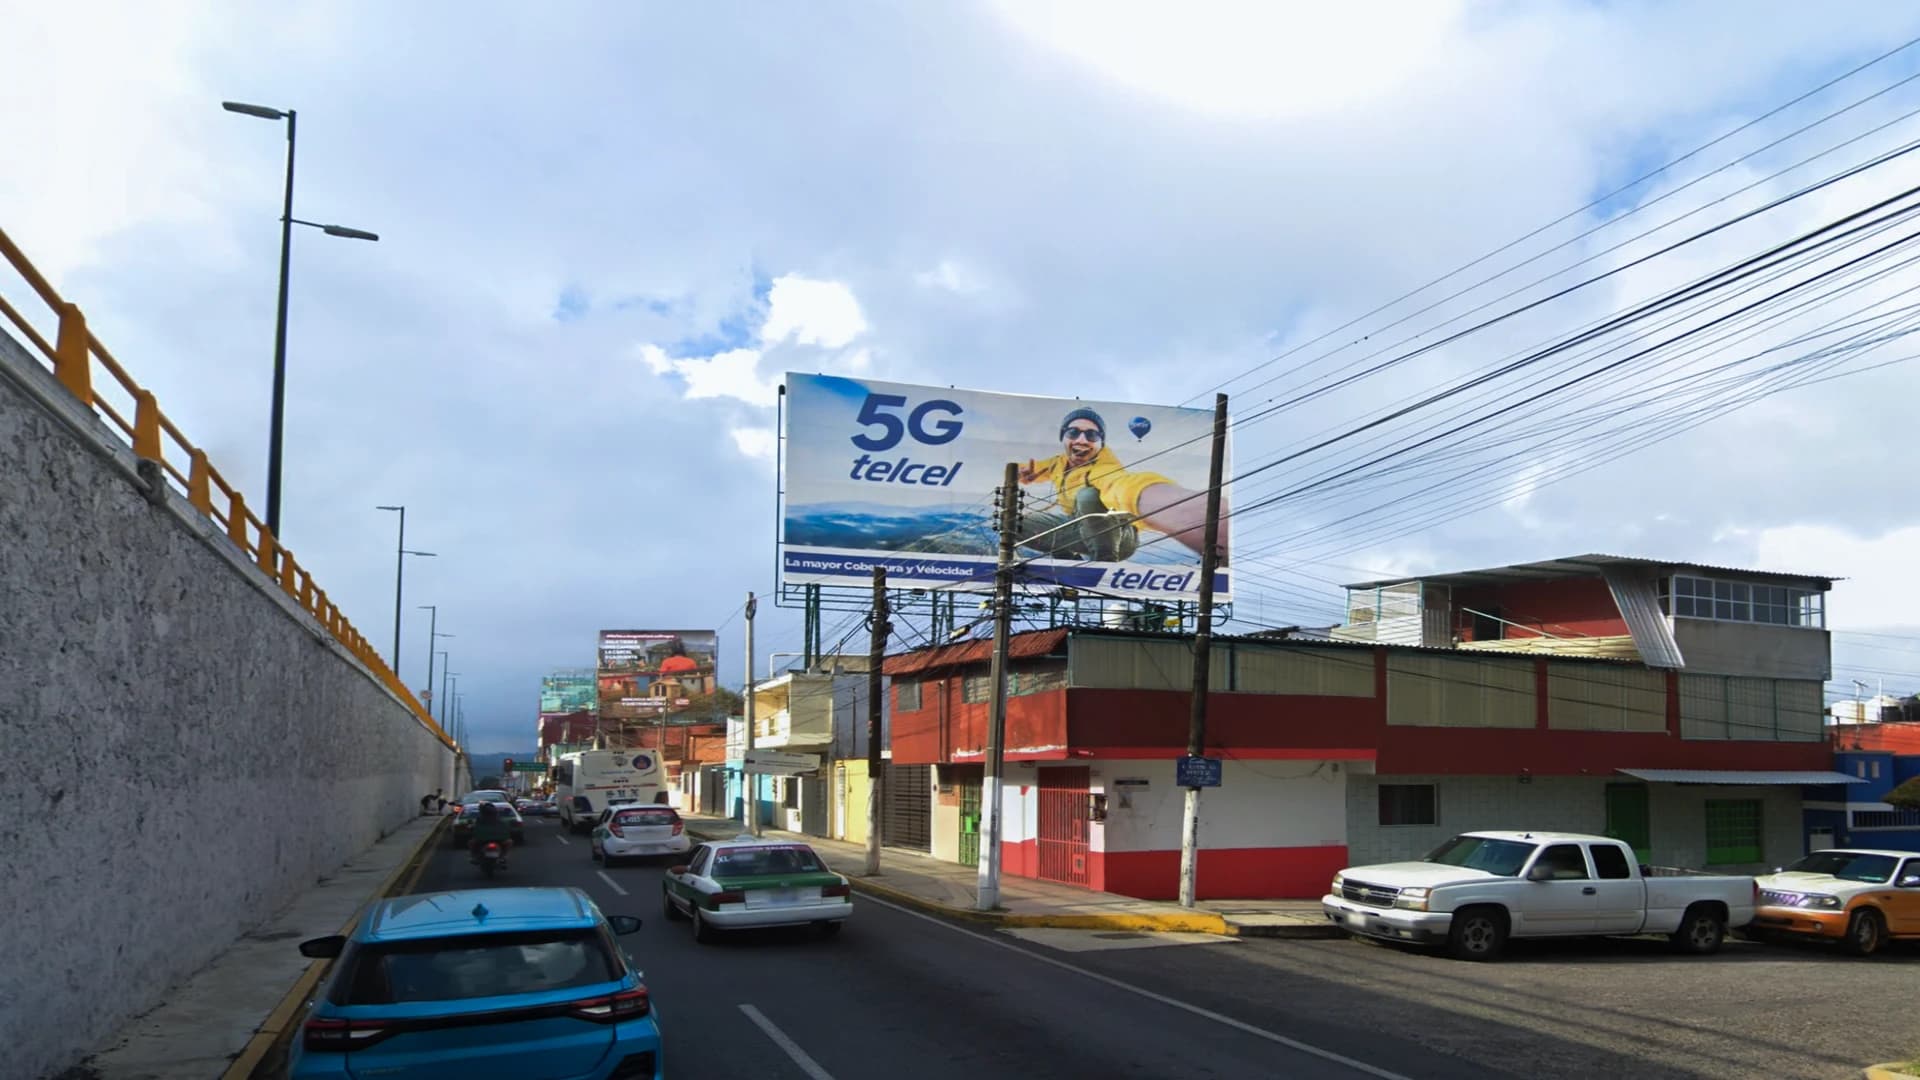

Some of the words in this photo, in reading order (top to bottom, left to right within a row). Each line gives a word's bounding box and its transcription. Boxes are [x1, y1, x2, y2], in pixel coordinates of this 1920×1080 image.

[850, 393, 964, 452] 5G
[850, 454, 964, 486] telcel
[785, 558, 800, 567] La
[802, 560, 842, 570] mayor
[844, 561, 904, 573] Cobeura
[905, 566, 914, 575] y
[916, 565, 974, 576] Velocidad
[1109, 568, 1195, 591] telcel
